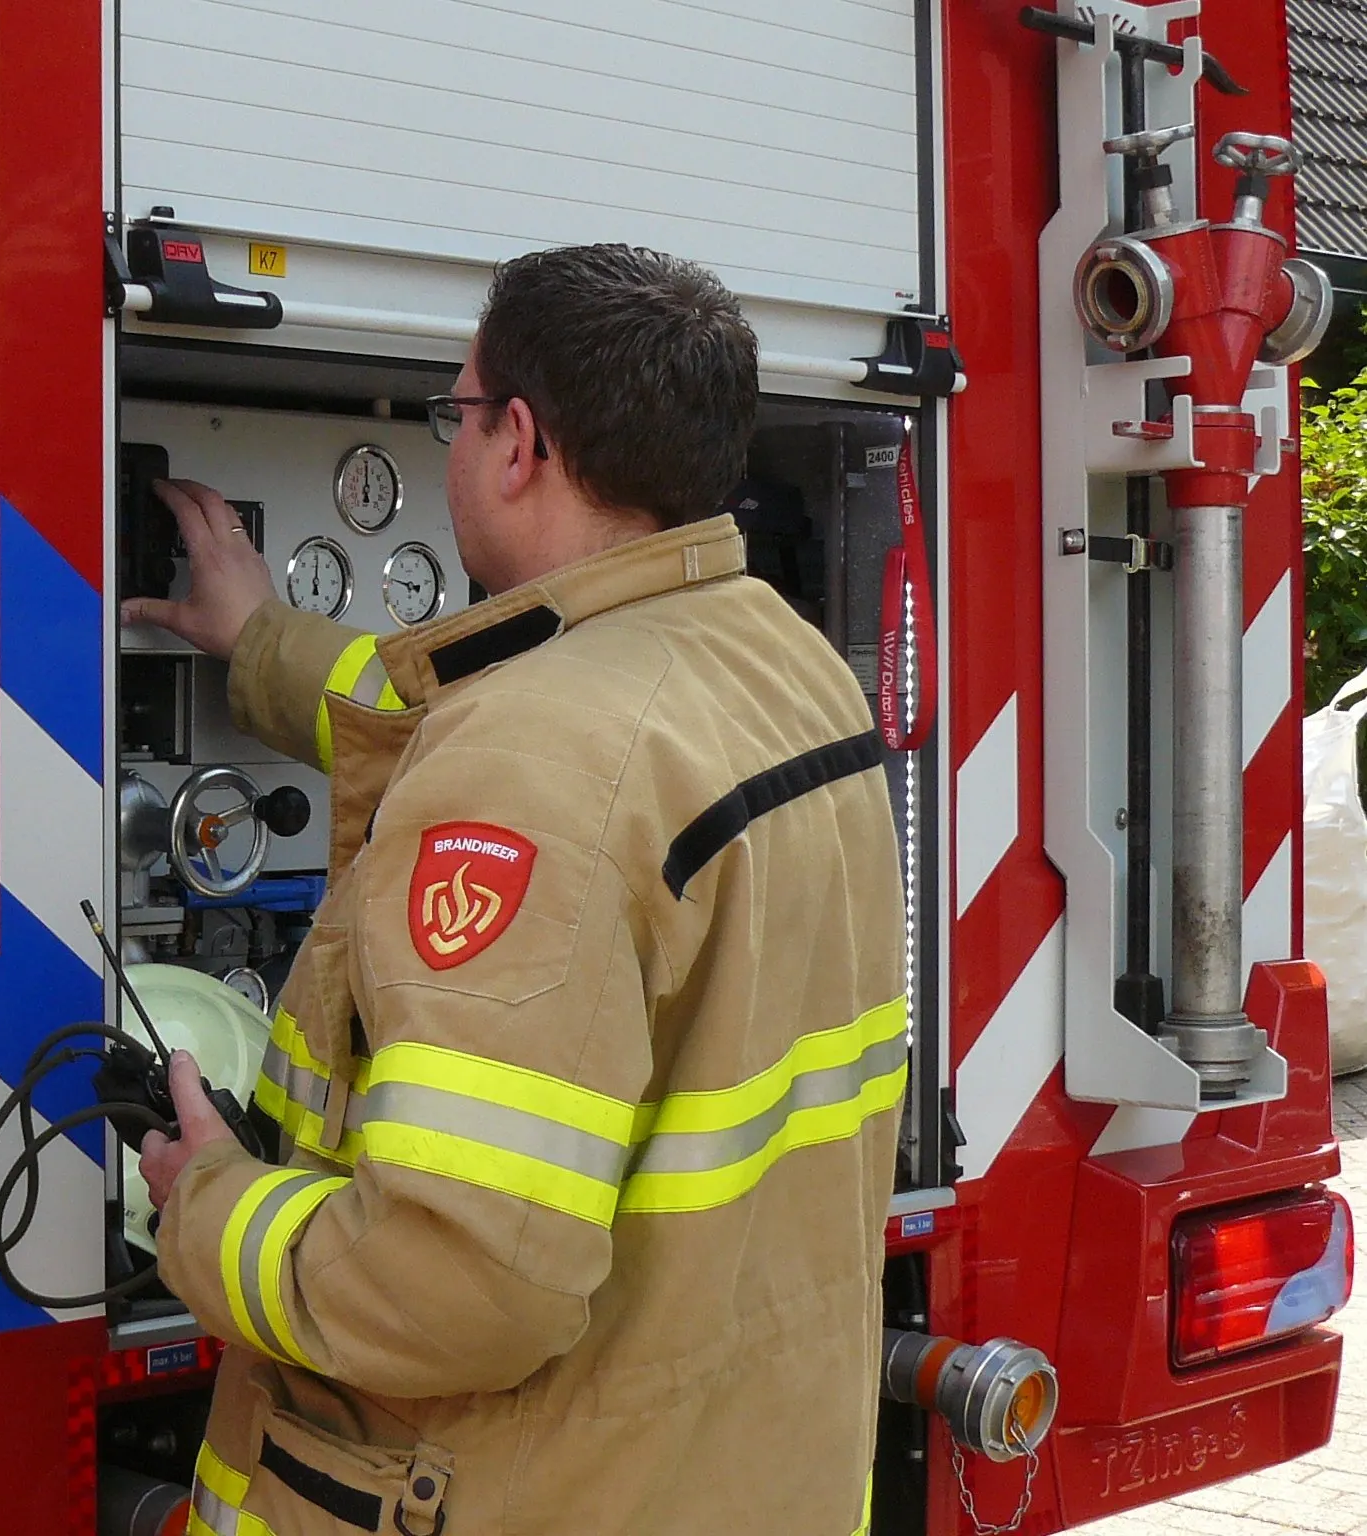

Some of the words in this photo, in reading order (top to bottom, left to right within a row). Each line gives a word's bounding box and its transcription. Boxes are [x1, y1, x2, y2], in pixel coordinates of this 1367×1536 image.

[259, 250, 278, 271] K7
[867, 450, 895, 465] 2400
[881, 670, 895, 722] Dutch
[434, 837, 519, 863] BRANDWEER
